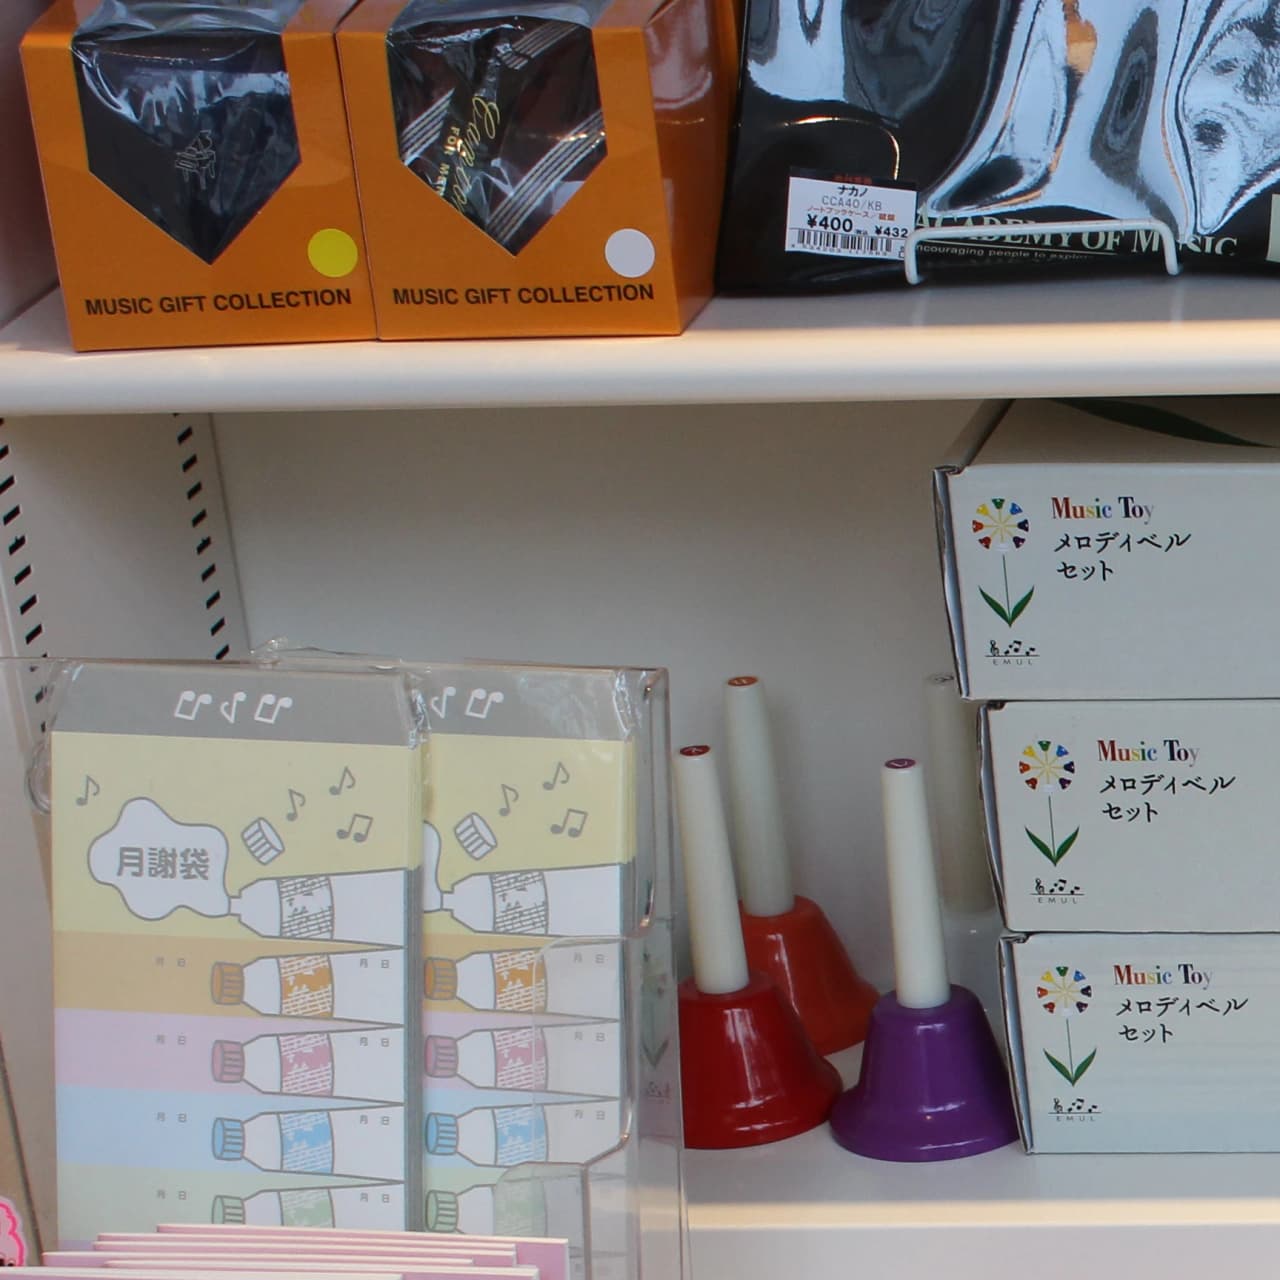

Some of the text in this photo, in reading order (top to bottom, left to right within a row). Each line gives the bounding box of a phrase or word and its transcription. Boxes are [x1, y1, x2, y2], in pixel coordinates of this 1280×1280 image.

[838, 185, 868, 198] ナカノ
[822, 195, 882, 212] CCA40/KB
[807, 213, 853, 233] ¥400
[875, 225, 909, 238] ¥432
[1081, 229, 1125, 251] OF
[1132, 228, 1238, 257] MSIC
[84, 288, 352, 316] MUSIC GIFT COLLECTION
[392, 283, 654, 305] MUSIC GIFT COLLECTION
[1051, 496, 1155, 525] Music Toy
[1054, 532, 1192, 553] メロディベル
[1056, 560, 1114, 581] セット
[1097, 739, 1201, 767] Music Toy
[1099, 774, 1236, 796] メロディベル
[1102, 801, 1158, 823] セット
[116, 846, 210, 881] 月謝袋
[1113, 963, 1213, 990] Music Toy
[1116, 997, 1249, 1017] メロディベル
[1118, 1023, 1173, 1043] セット
